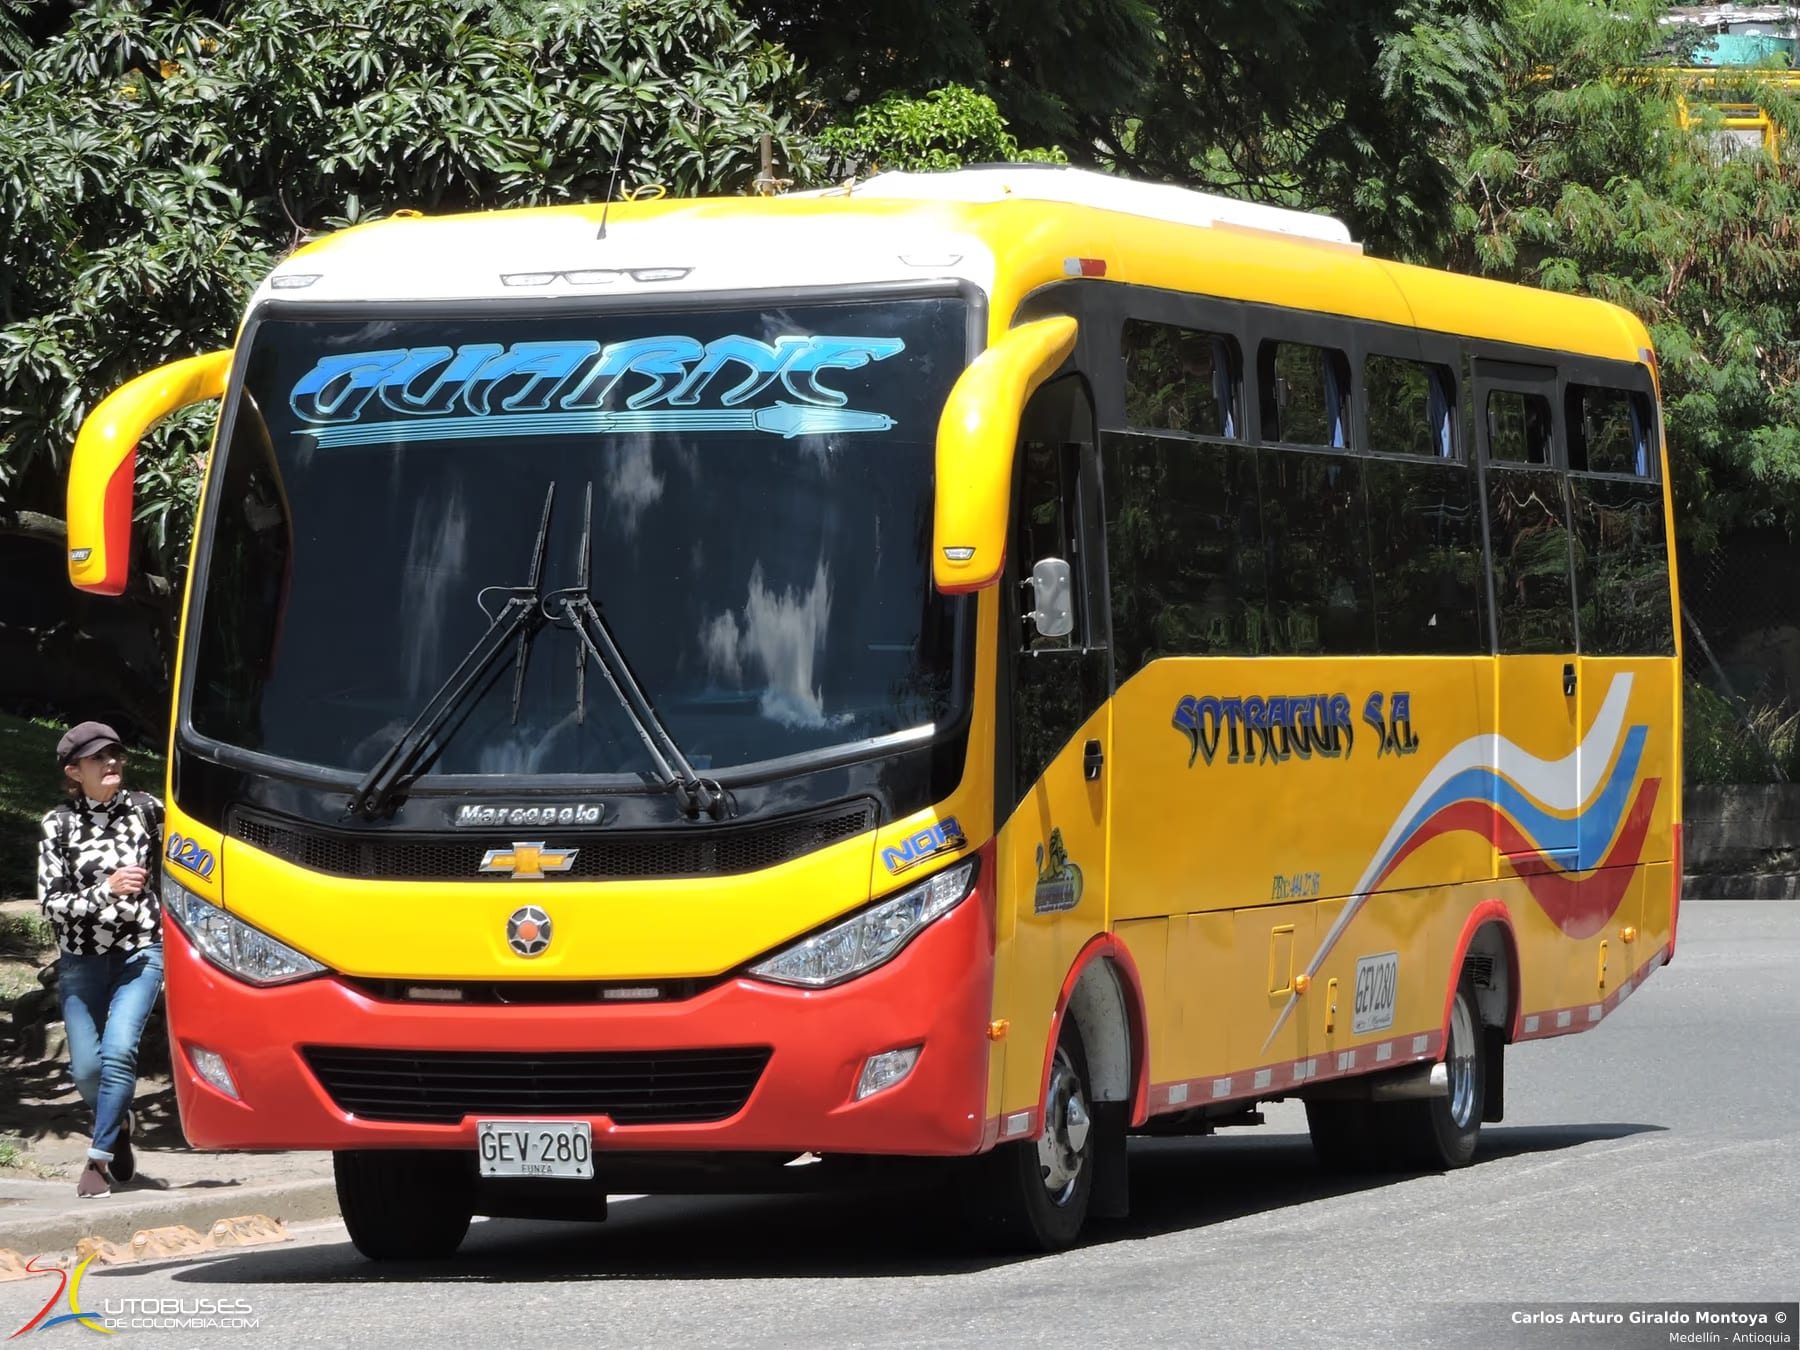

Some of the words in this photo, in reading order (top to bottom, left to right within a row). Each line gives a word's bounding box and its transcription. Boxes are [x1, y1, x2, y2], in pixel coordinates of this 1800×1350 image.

[456, 803, 603, 826] Marcopolo
[166, 831, 217, 878] 020
[1355, 961, 1396, 1014] GEV280
[521, 1164, 552, 1173] FUNZA
